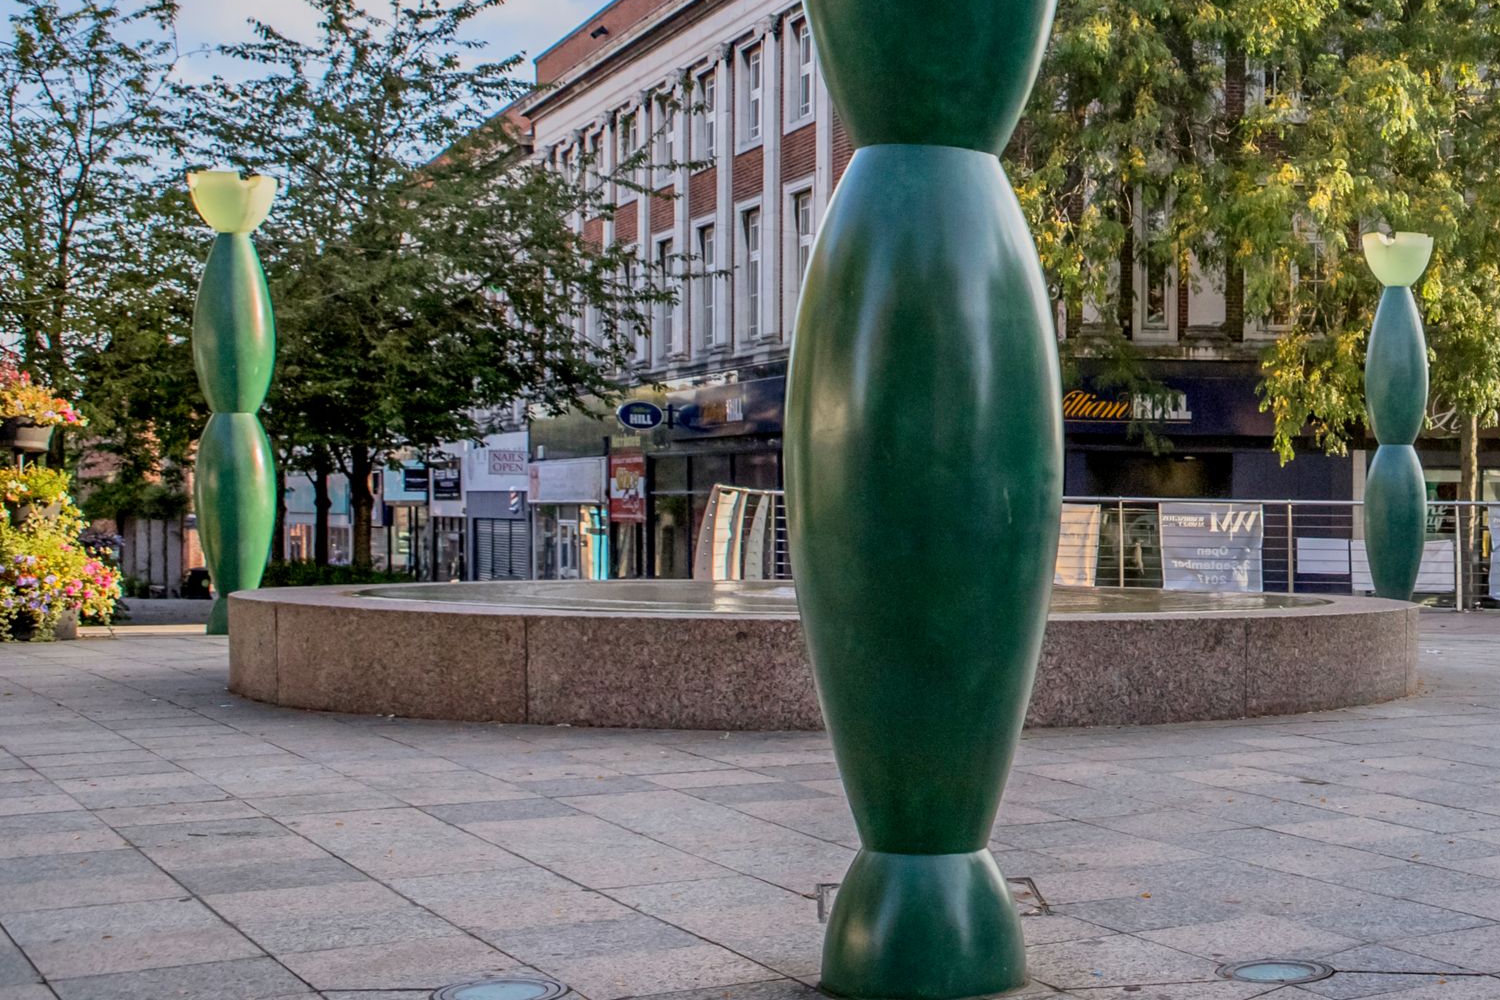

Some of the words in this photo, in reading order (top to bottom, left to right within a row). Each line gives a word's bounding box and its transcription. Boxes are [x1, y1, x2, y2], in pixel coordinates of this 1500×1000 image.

[1063, 390, 1132, 419] illiam
[629, 413, 653, 425] HILL
[492, 453, 524, 462] NAILS
[492, 463, 523, 472] OPEN
